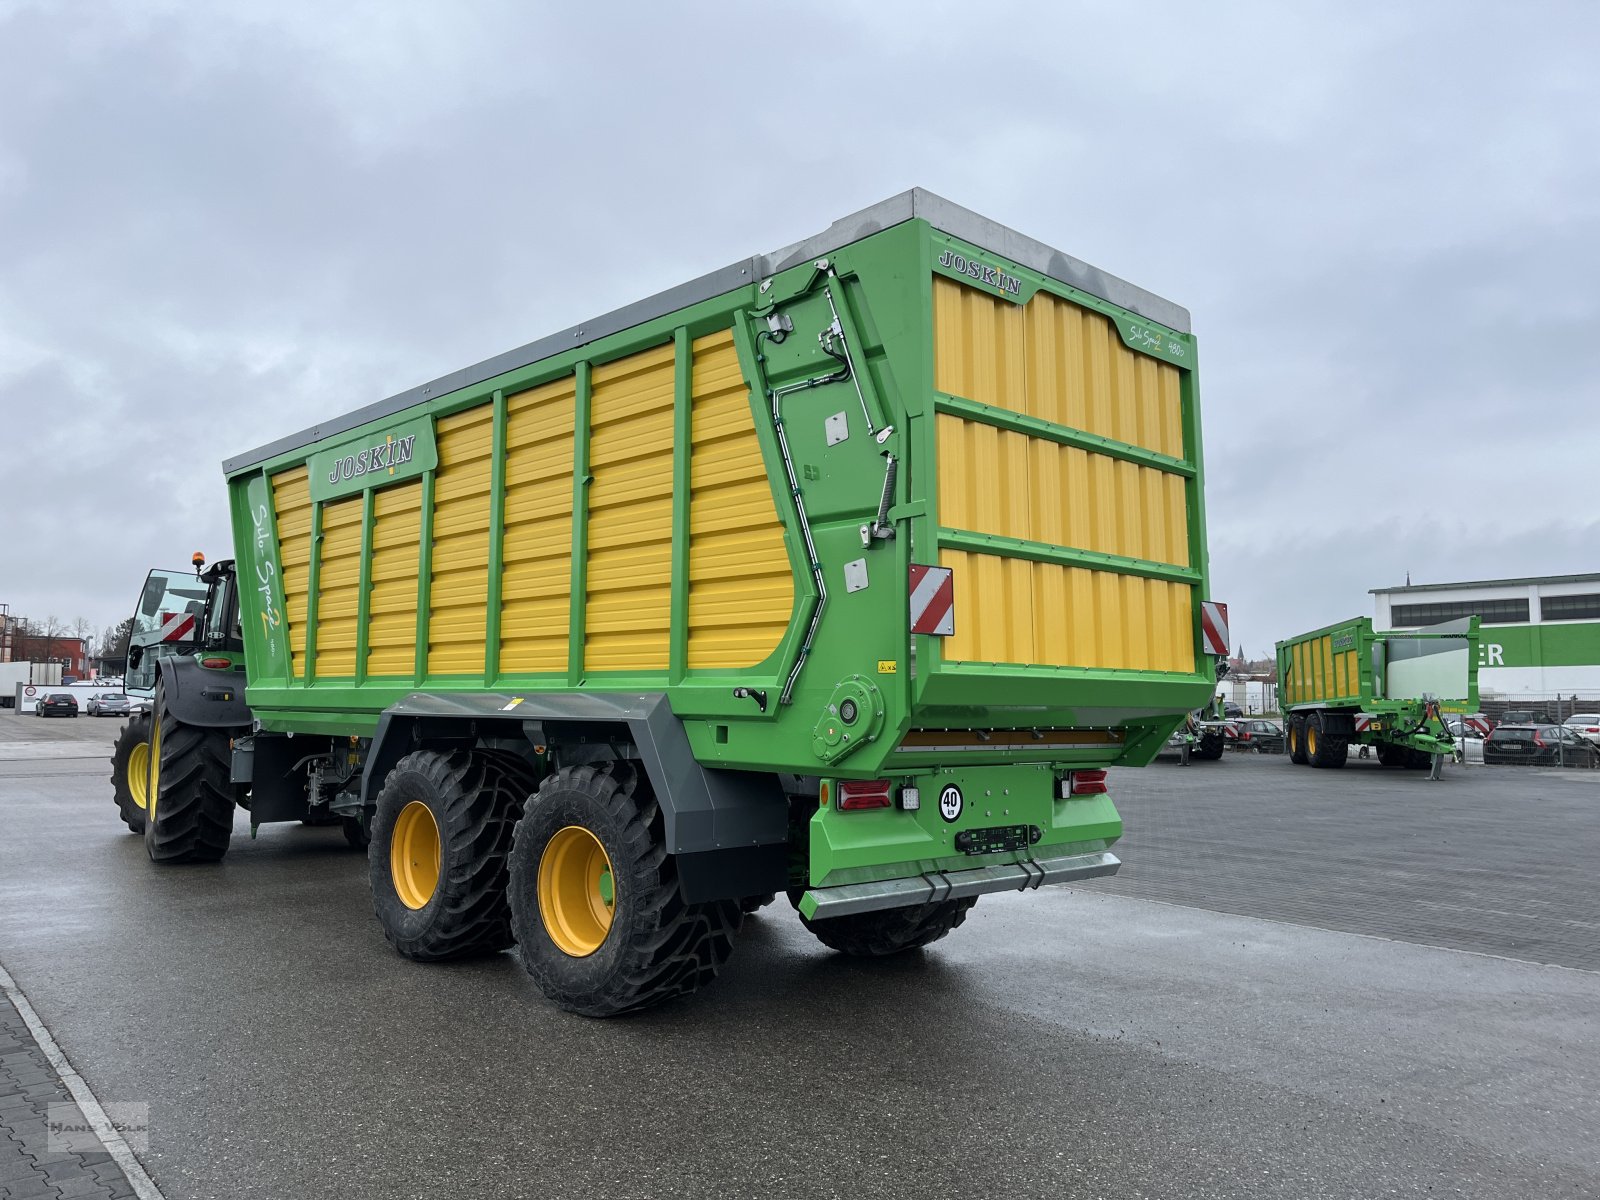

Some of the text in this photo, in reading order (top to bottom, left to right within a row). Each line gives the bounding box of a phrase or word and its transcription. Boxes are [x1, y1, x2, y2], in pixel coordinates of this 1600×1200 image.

[939, 250, 1020, 295] JOSKIN
[329, 435, 415, 483] JOSKIN
[943, 791, 957, 808] 40
